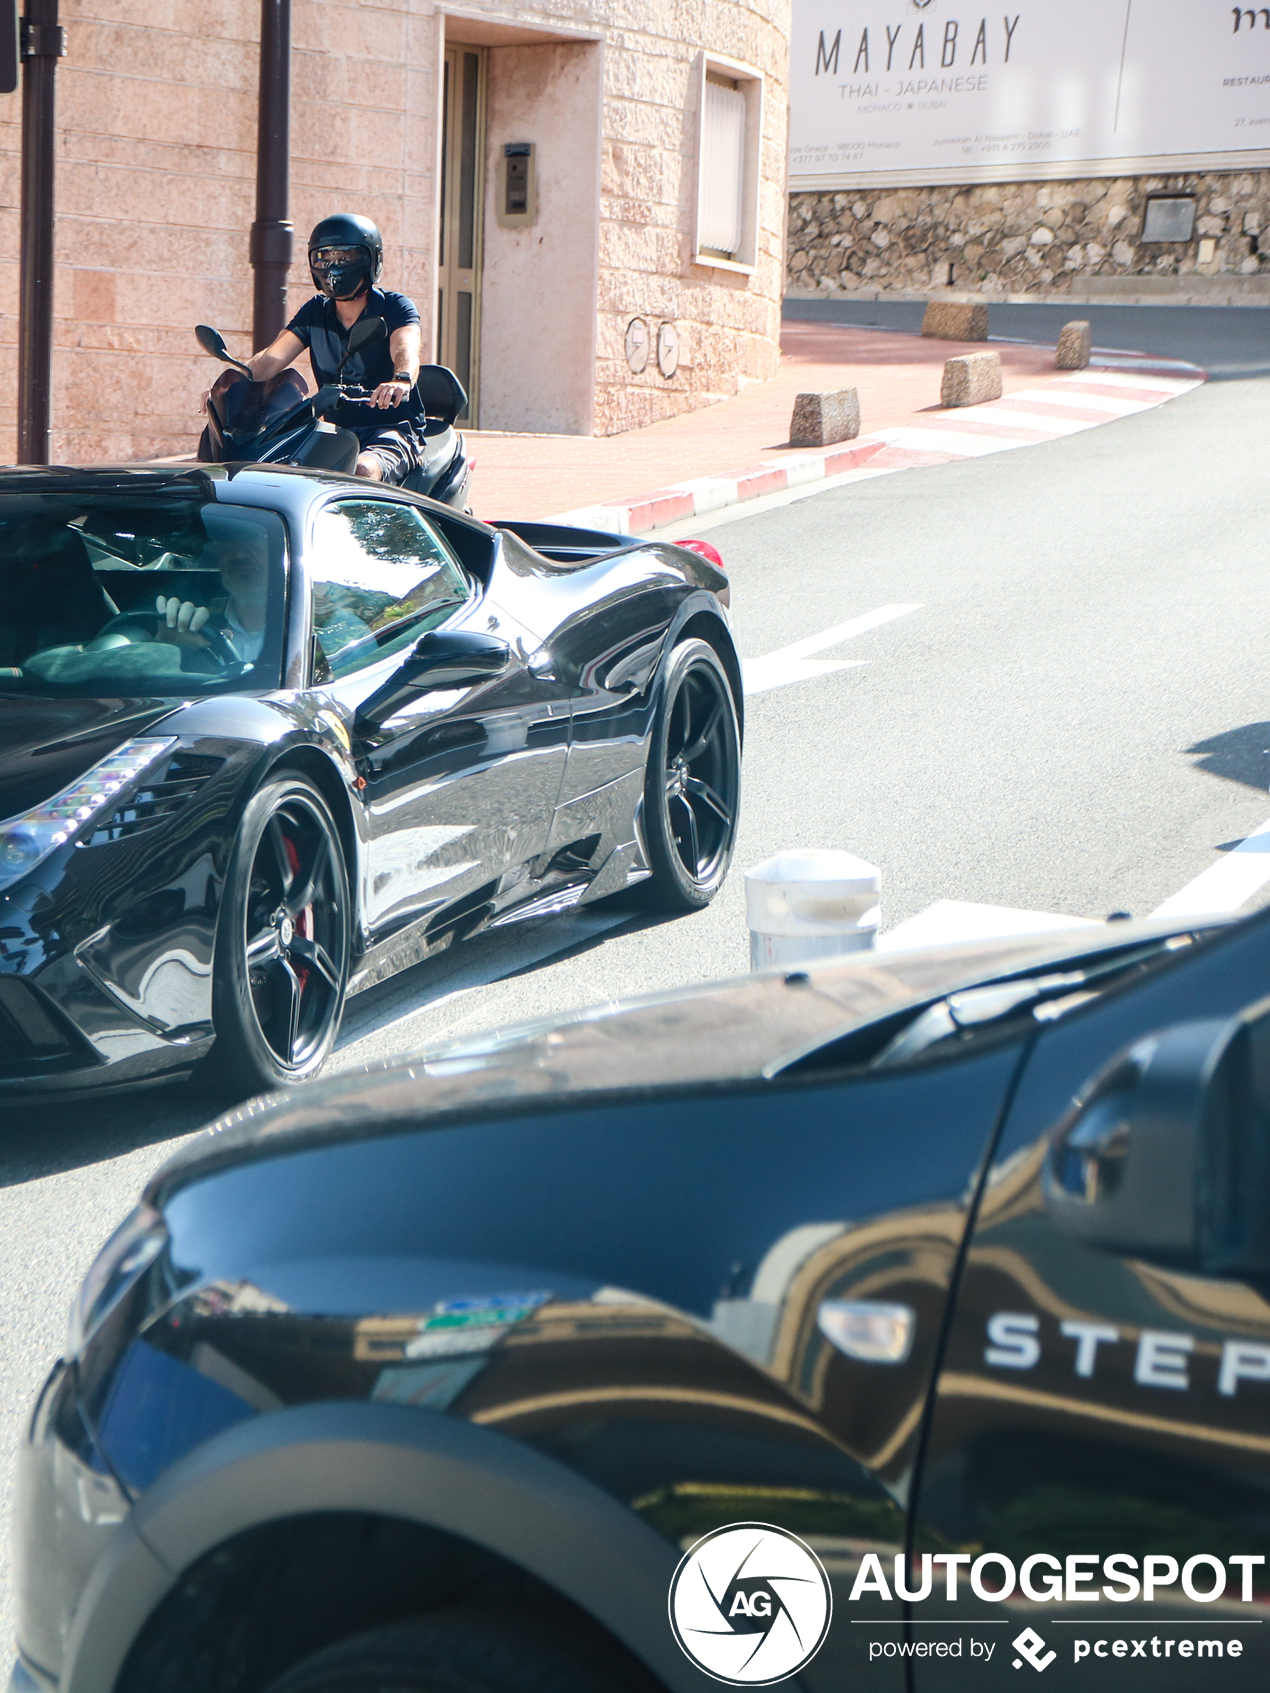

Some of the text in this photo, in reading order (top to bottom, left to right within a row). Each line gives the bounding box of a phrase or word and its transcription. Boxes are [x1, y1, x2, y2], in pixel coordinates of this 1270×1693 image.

[815, 15, 1020, 76] MAYABAY
[838, 83, 879, 99] THAI
[895, 75, 988, 96] JAPANESE
[857, 101, 947, 114] MONACO DUBAI
[984, 1311, 1270, 1397] STEP
